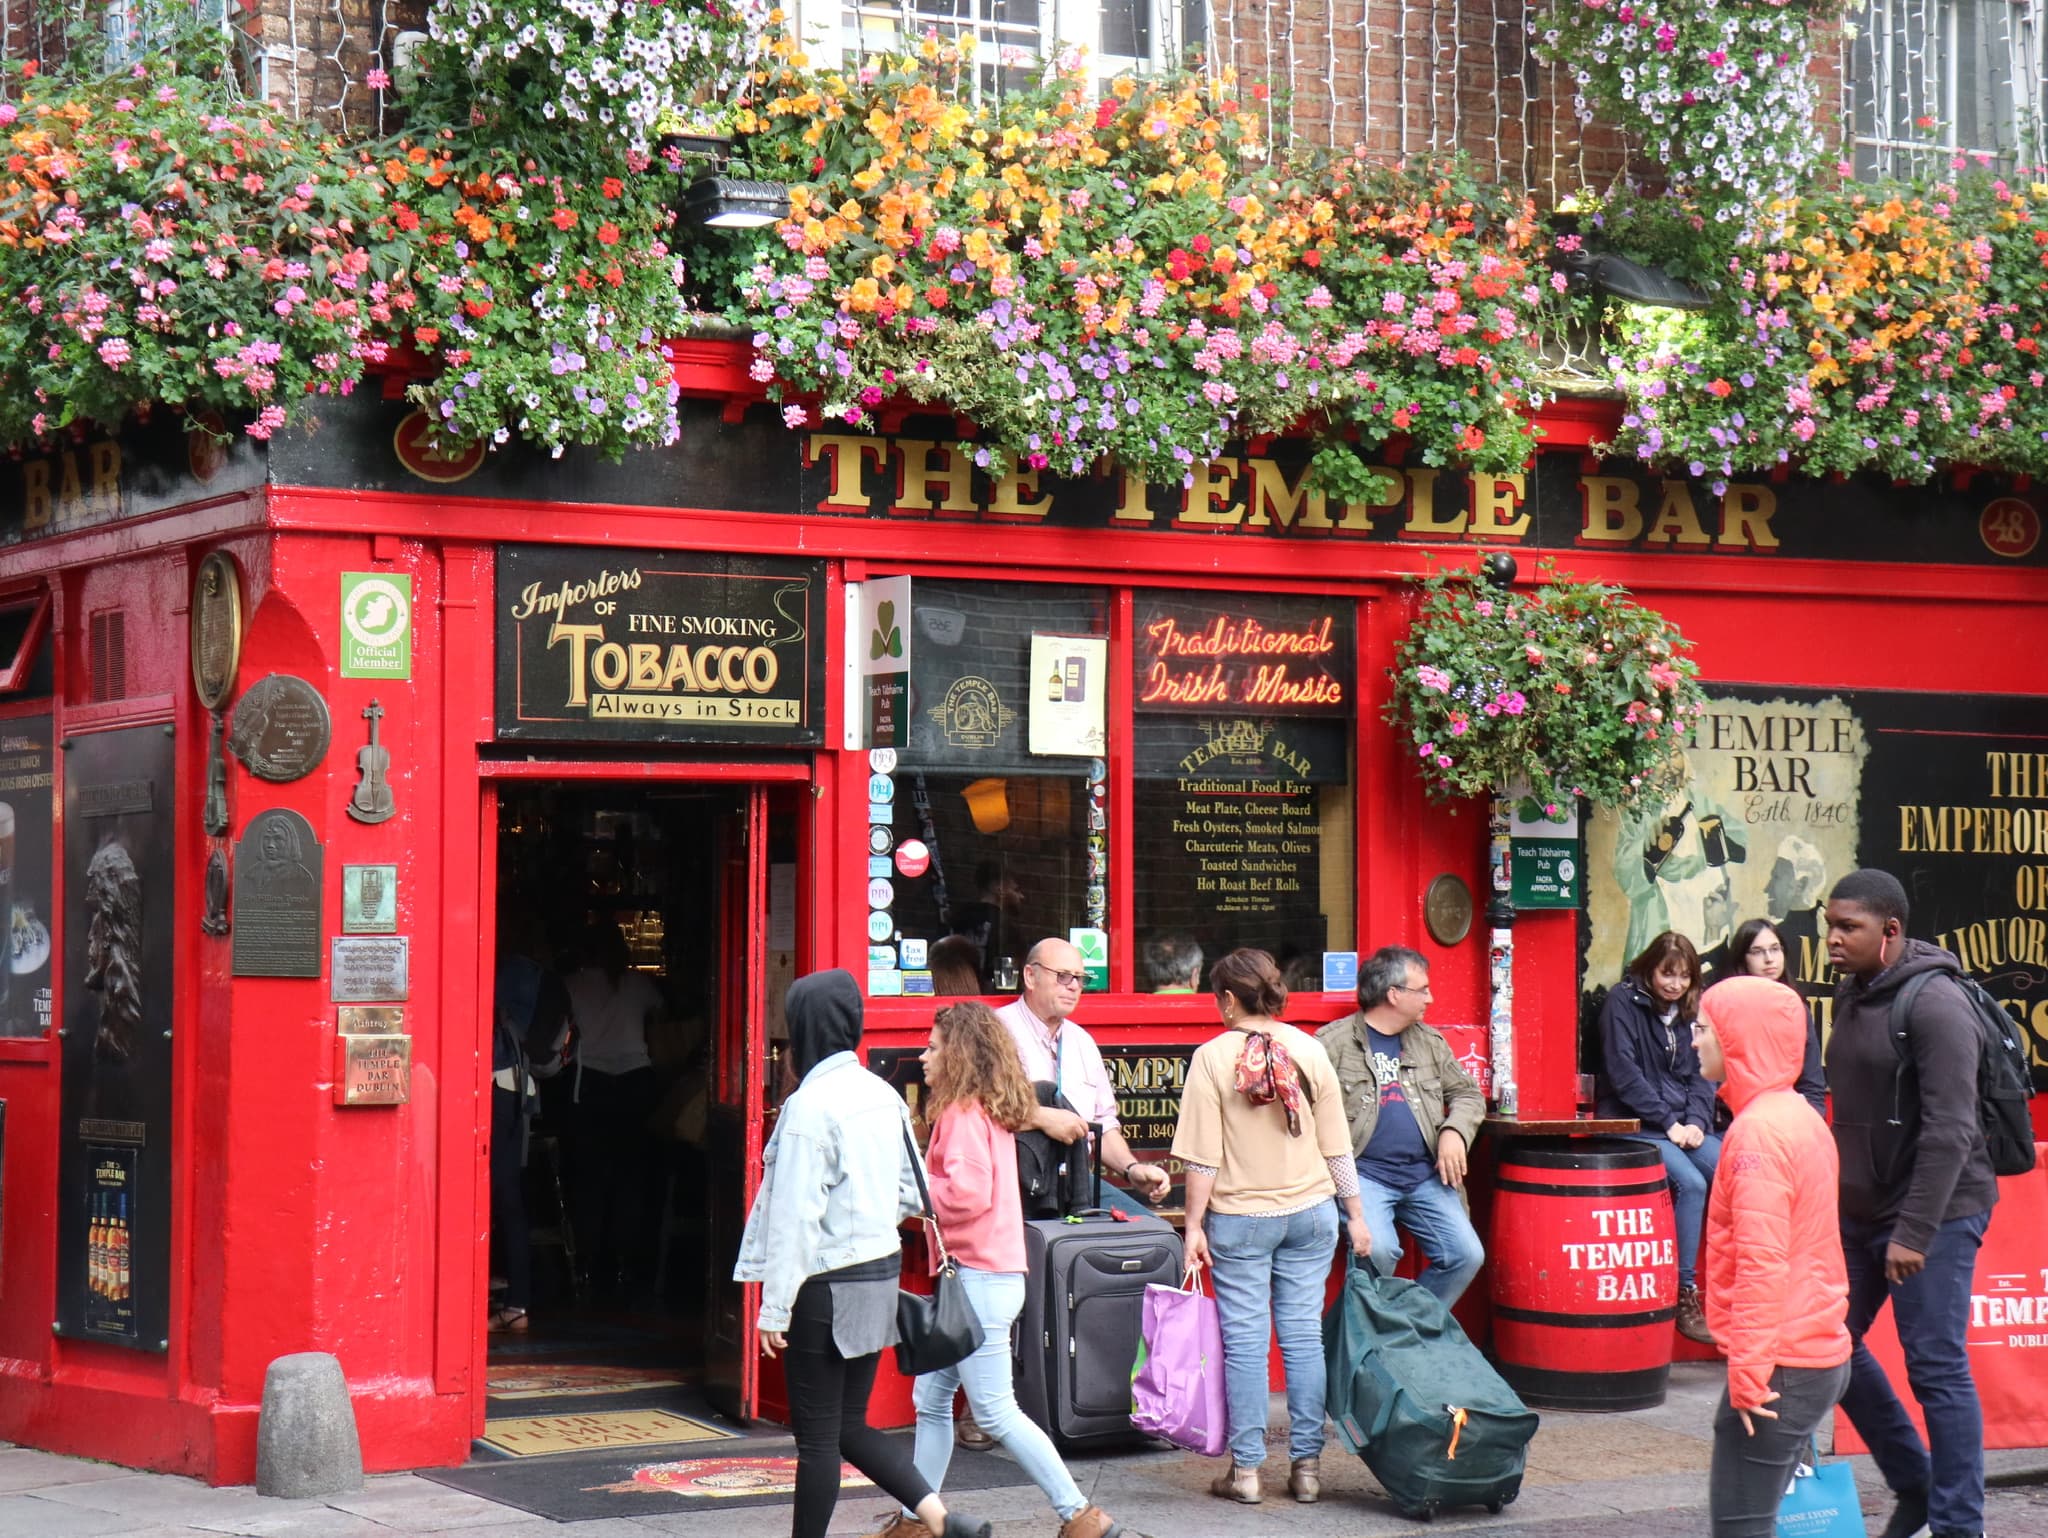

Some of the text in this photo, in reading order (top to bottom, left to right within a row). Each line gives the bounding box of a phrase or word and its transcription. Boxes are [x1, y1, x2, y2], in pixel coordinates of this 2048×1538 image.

[22, 440, 122, 529] BAR
[804, 433, 1054, 521] THE
[1576, 475, 1780, 551] BAR
[1988, 510, 2025, 544] 48
[511, 567, 641, 621] Importers
[594, 601, 617, 615] OF
[628, 614, 776, 638] FINE SMOKING
[1148, 616, 1334, 657] Traditional
[356, 646, 397, 657] Official
[352, 657, 400, 668] Member
[547, 623, 779, 708] TOBACCO
[954, 679, 989, 693] TEMPLE
[1141, 661, 1342, 704] Irish Music
[596, 695, 795, 719] Always in Stock
[881, 699, 891, 709] Pub
[1179, 735, 1312, 779] TEMPLE BAR
[1732, 755, 1816, 798] BAR
[1177, 778, 1312, 794] Traditional Food Fare
[1186, 801, 1311, 816] Meat Plate, Cheese Board
[1804, 800, 1850, 829] 1840
[1173, 819, 1322, 838] Fresh Oysters, Smoked Salmon
[1898, 806, 2048, 855] EMPEROR
[1185, 839, 1311, 854] Charcuterie Meats, Olives
[1517, 847, 1537, 857] Teach
[1200, 858, 1297, 873] Toasted Sandwiches
[1537, 860, 1551, 870] Pub
[1197, 877, 1300, 891] Hot Roast Beef Rolls
[905, 944, 921, 954] tax
[906, 954, 925, 963] free
[353, 1018, 389, 1029] Ashtray
[358, 1060, 400, 1069] TEMPLE
[367, 1071, 389, 1080] BAR
[356, 1082, 400, 1092] DUBLIN
[1148, 1123, 1175, 1138] 1840
[1591, 1208, 1655, 1237] THE
[1562, 1238, 1674, 1270] TEMPLE
[1596, 1272, 1659, 1301] BAR
[495, 1418, 690, 1442] TEMPLE
